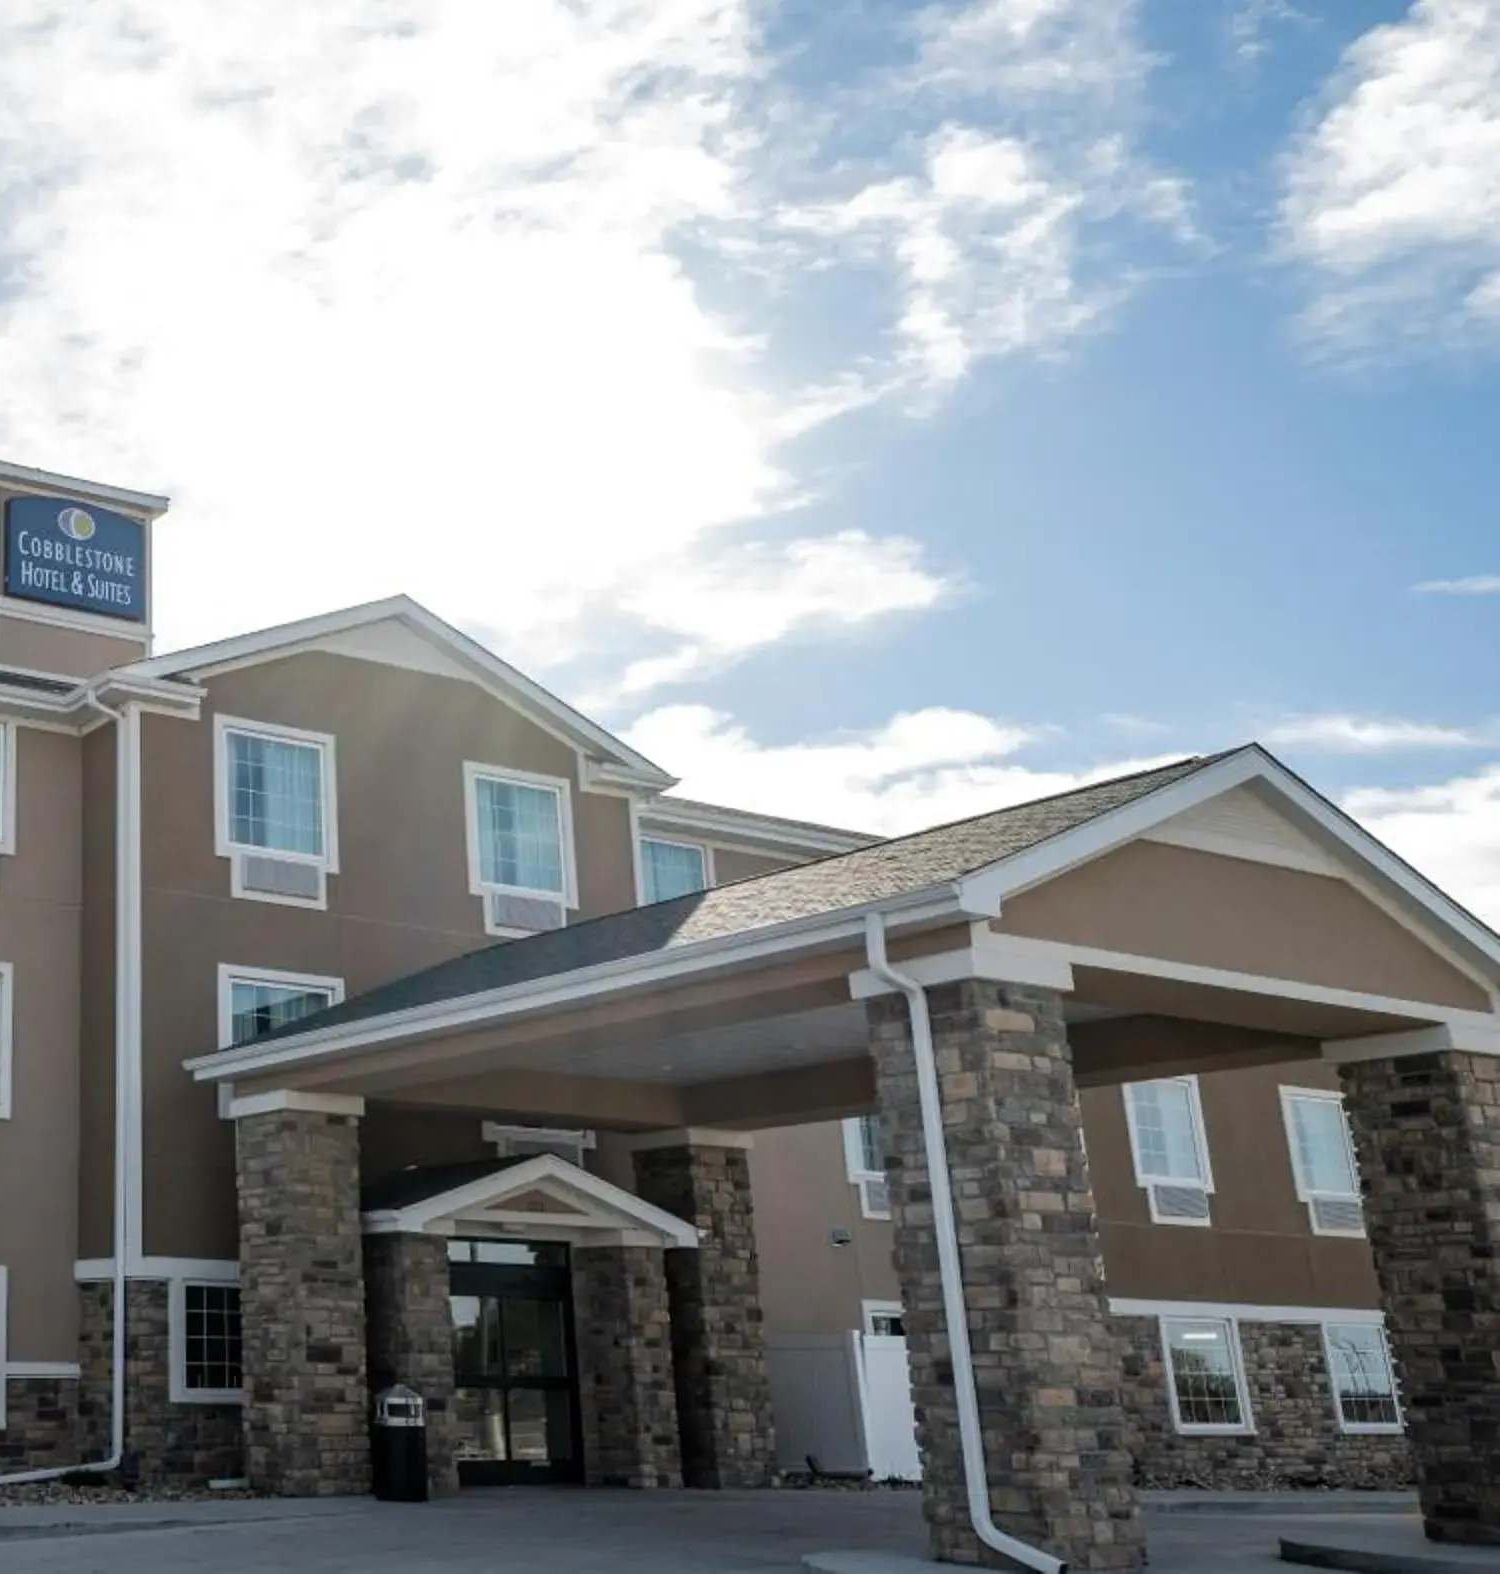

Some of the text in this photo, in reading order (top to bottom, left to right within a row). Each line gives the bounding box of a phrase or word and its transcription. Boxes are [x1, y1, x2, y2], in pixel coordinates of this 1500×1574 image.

[19, 531, 135, 577] COBBLESTONE
[21, 559, 132, 605] HOTEL & SUITES
